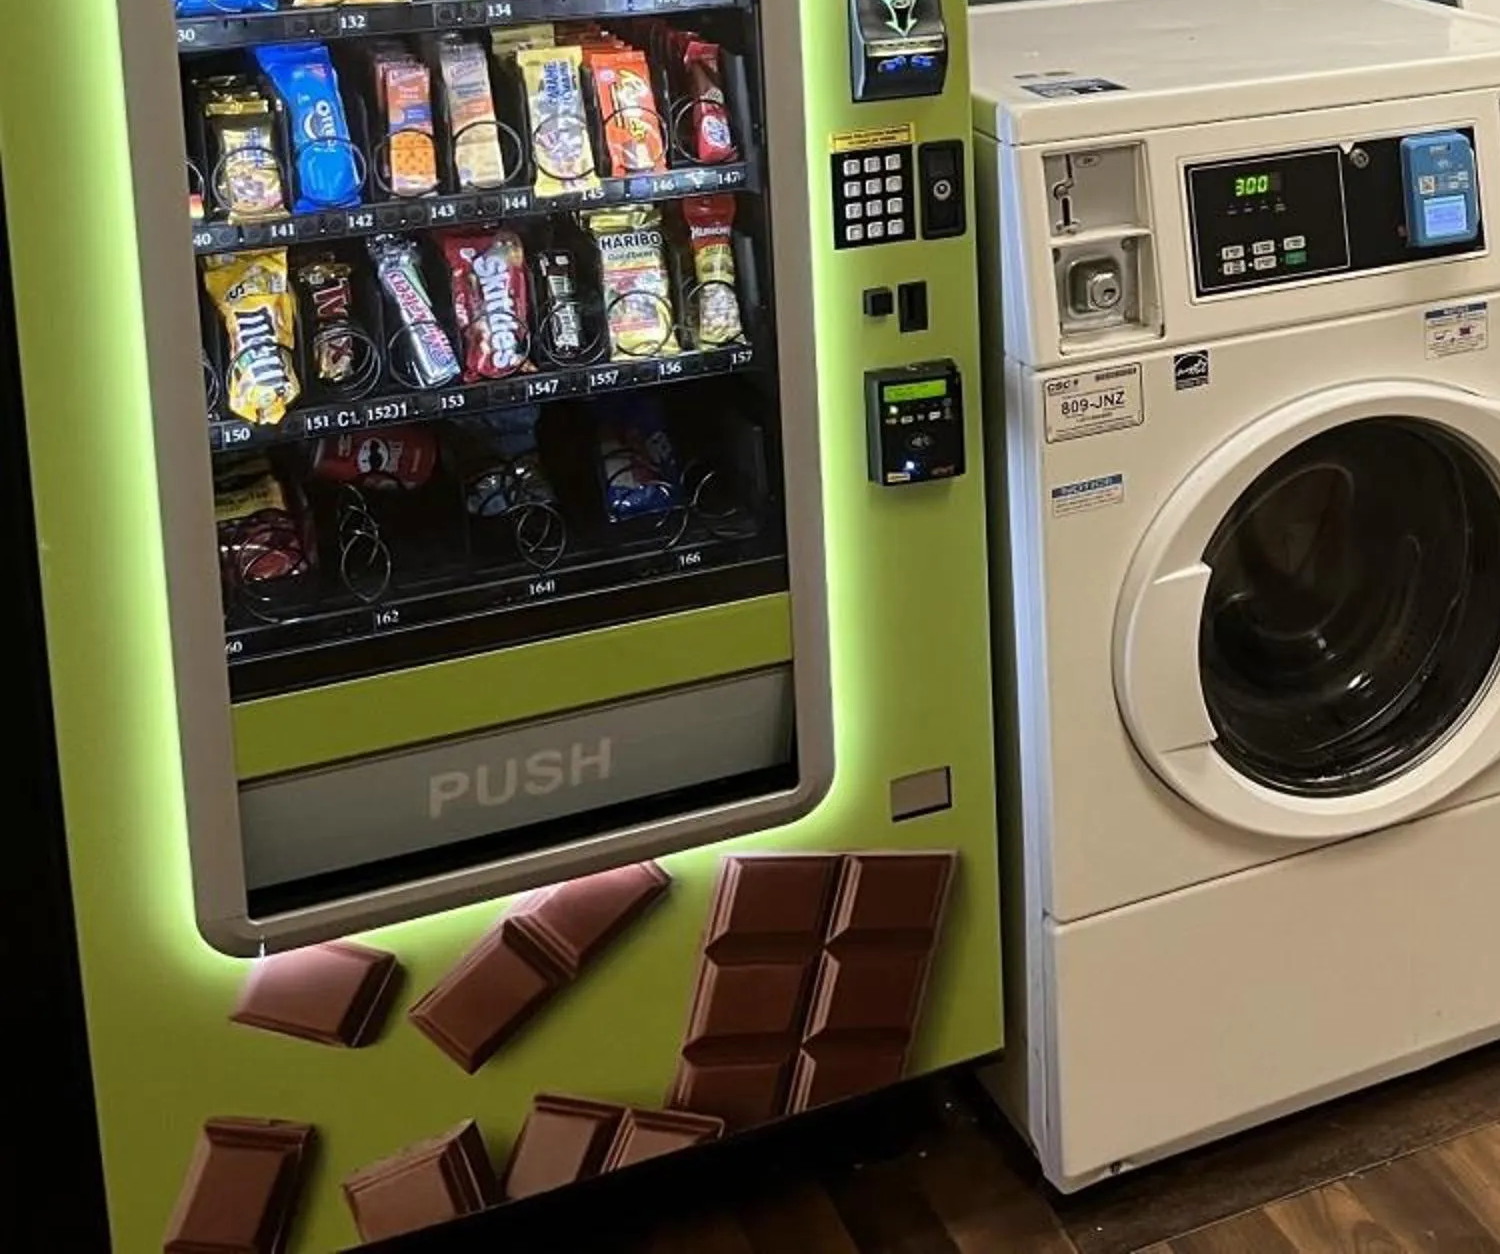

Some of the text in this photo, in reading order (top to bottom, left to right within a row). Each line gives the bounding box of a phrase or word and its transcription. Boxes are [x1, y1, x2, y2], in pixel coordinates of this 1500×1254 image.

[177, 29, 195, 42] 30
[340, 16, 365, 29] 132
[487, 4, 512, 18] 134
[1235, 175, 1270, 197] 300
[193, 234, 211, 246] 40
[271, 224, 295, 237] 141
[349, 215, 373, 228] 142
[430, 206, 455, 219] 143
[505, 197, 527, 209] 144
[601, 232, 662, 250] HARIBO
[224, 428, 250, 443] 150
[307, 415, 330, 430] 151
[441, 396, 465, 409] 153
[660, 361, 682, 375] 156
[732, 351, 752, 364] 157
[1061, 391, 1125, 415] 809-JNZ
[225, 641, 242, 654] 60
[376, 610, 399, 625] 162
[679, 553, 700, 567] 166
[429, 737, 612, 819] PUSH
